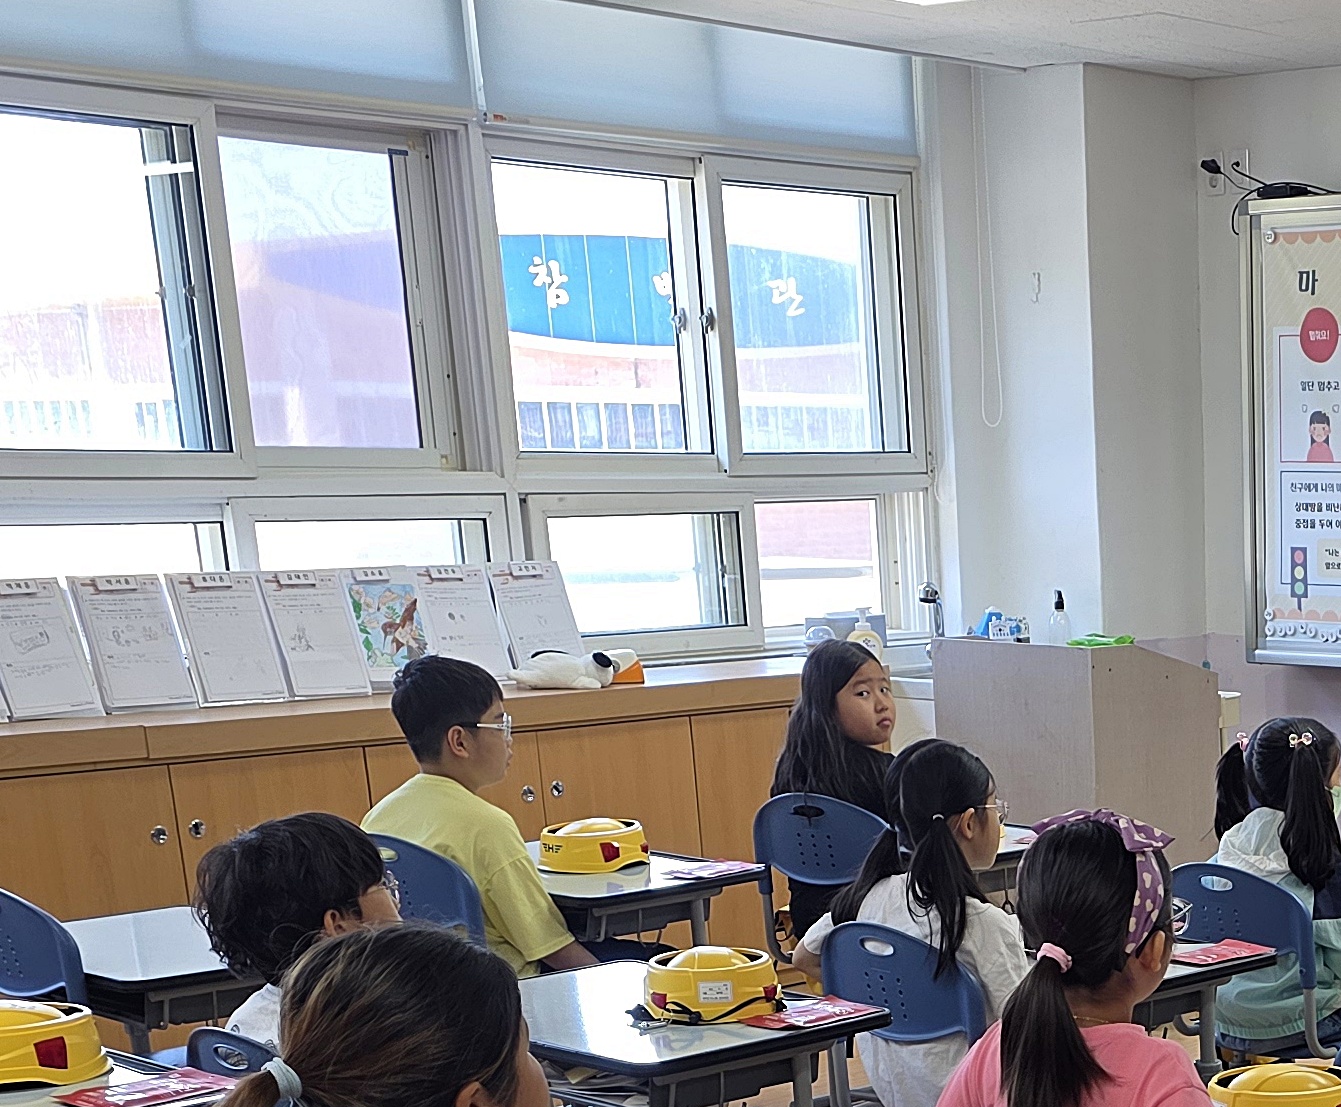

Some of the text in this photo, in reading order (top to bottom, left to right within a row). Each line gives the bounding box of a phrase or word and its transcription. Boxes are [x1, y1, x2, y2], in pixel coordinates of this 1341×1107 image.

[528, 256, 570, 308] 참
[1317, 380, 1340, 391] 멈추고
[1290, 482, 1318, 493] 친구에게
[1320, 482, 1335, 493] 나의
[1295, 502, 1323, 513] 상대방을
